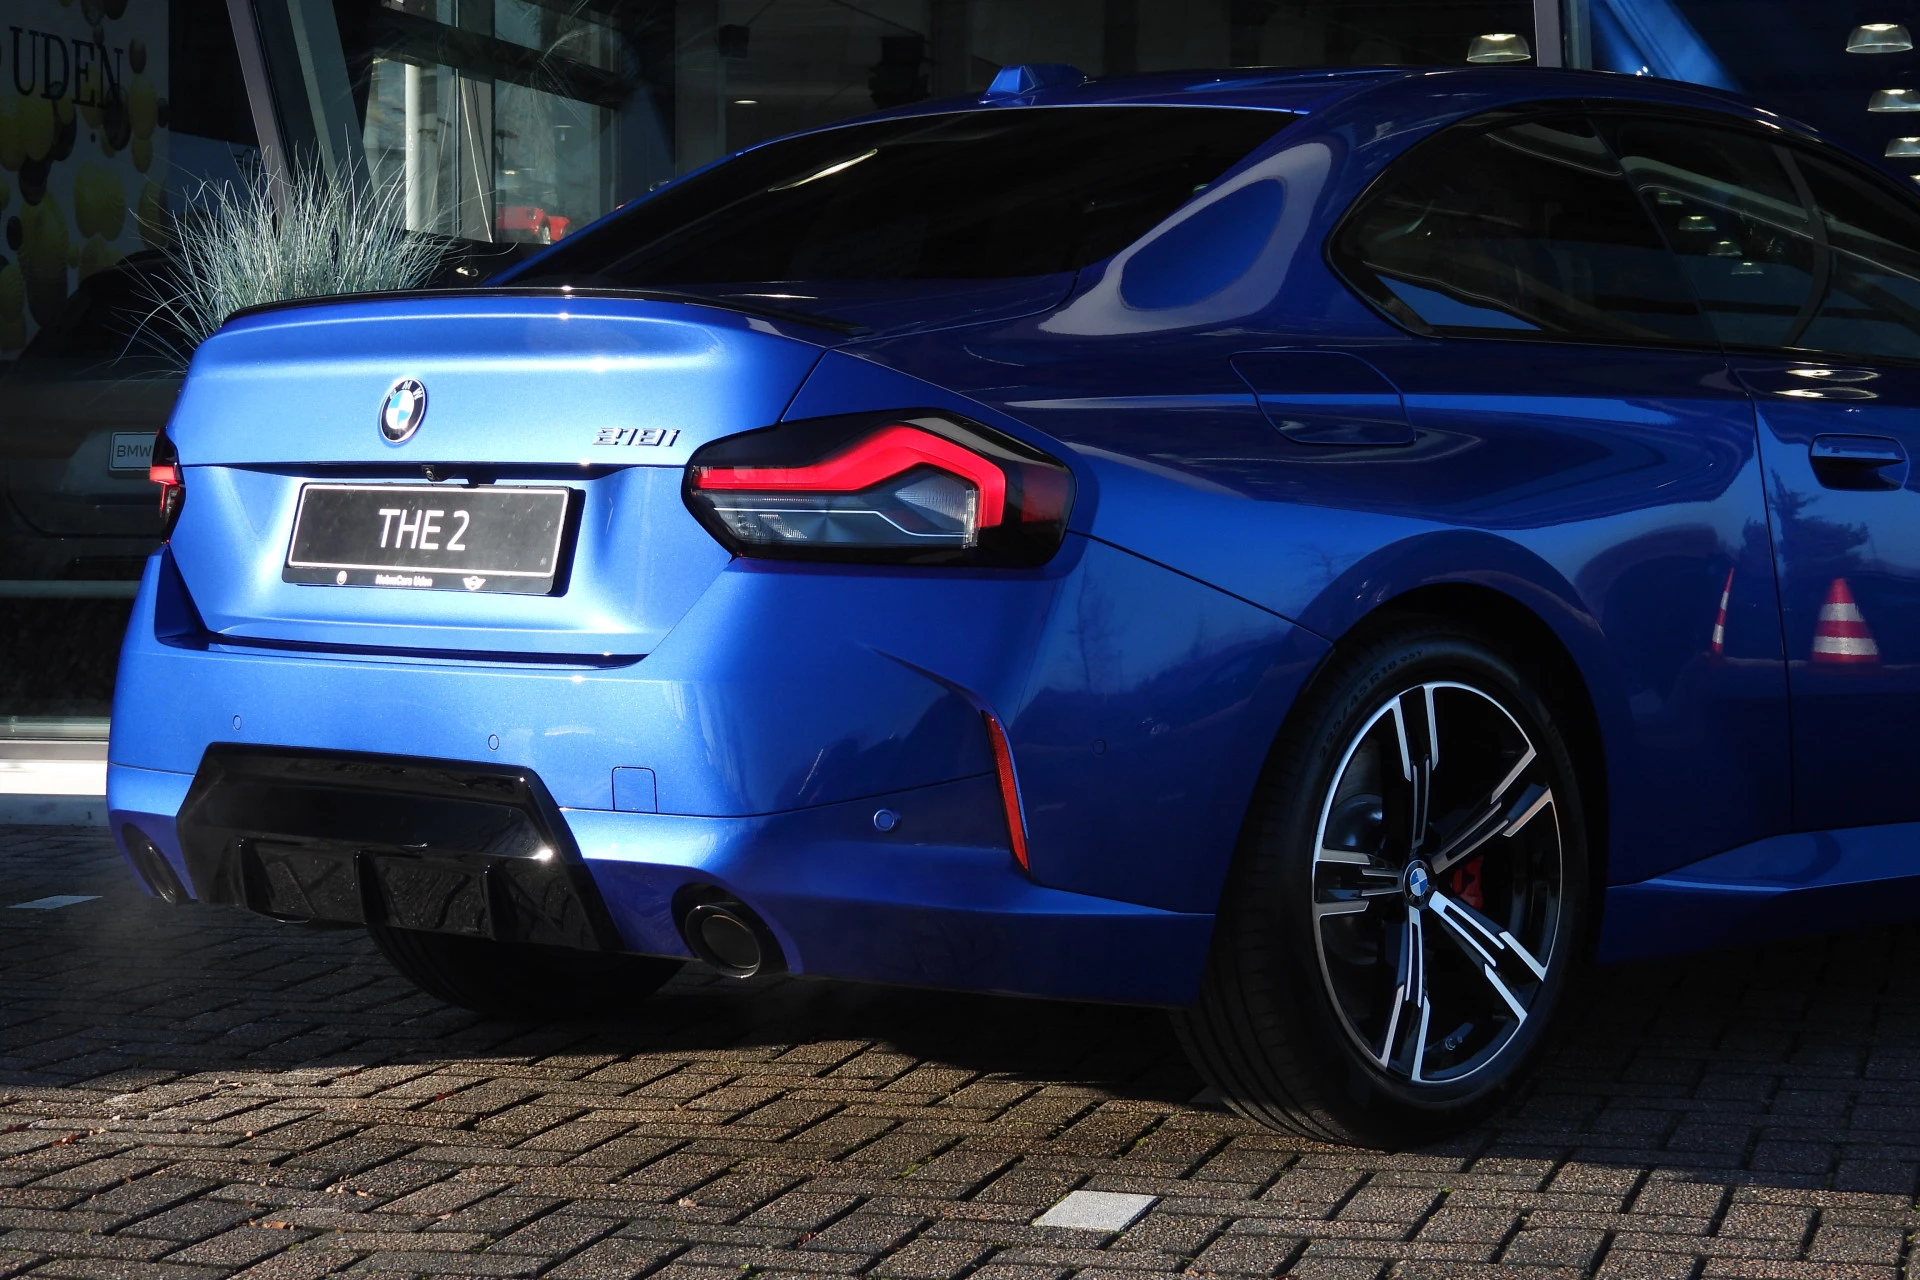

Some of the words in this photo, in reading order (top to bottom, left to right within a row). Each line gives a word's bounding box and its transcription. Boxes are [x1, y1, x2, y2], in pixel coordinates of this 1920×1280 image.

[9, 26, 124, 109] UDEN
[389, 380, 424, 401] BMW
[117, 445, 152, 457] BMW
[379, 508, 445, 549] THE
[446, 509, 470, 551] 2
